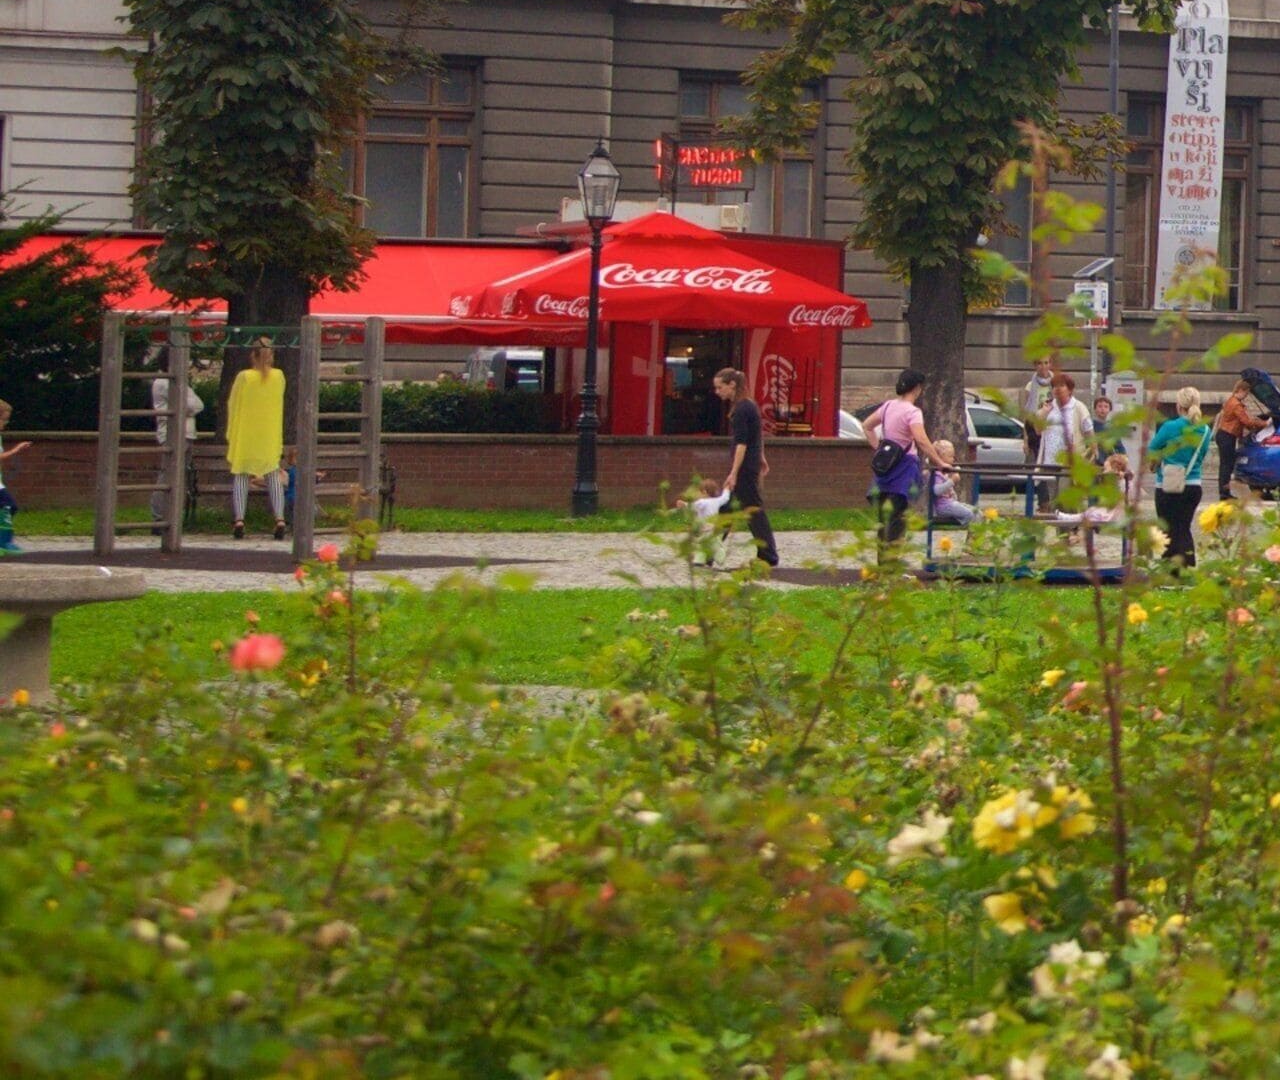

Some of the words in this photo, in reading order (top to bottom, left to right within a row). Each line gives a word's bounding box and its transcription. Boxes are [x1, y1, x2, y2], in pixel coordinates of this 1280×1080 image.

[599, 263, 777, 295] Coca-Cola
[535, 293, 606, 319] Coca-Co
[788, 304, 860, 327] Coca-Cola
